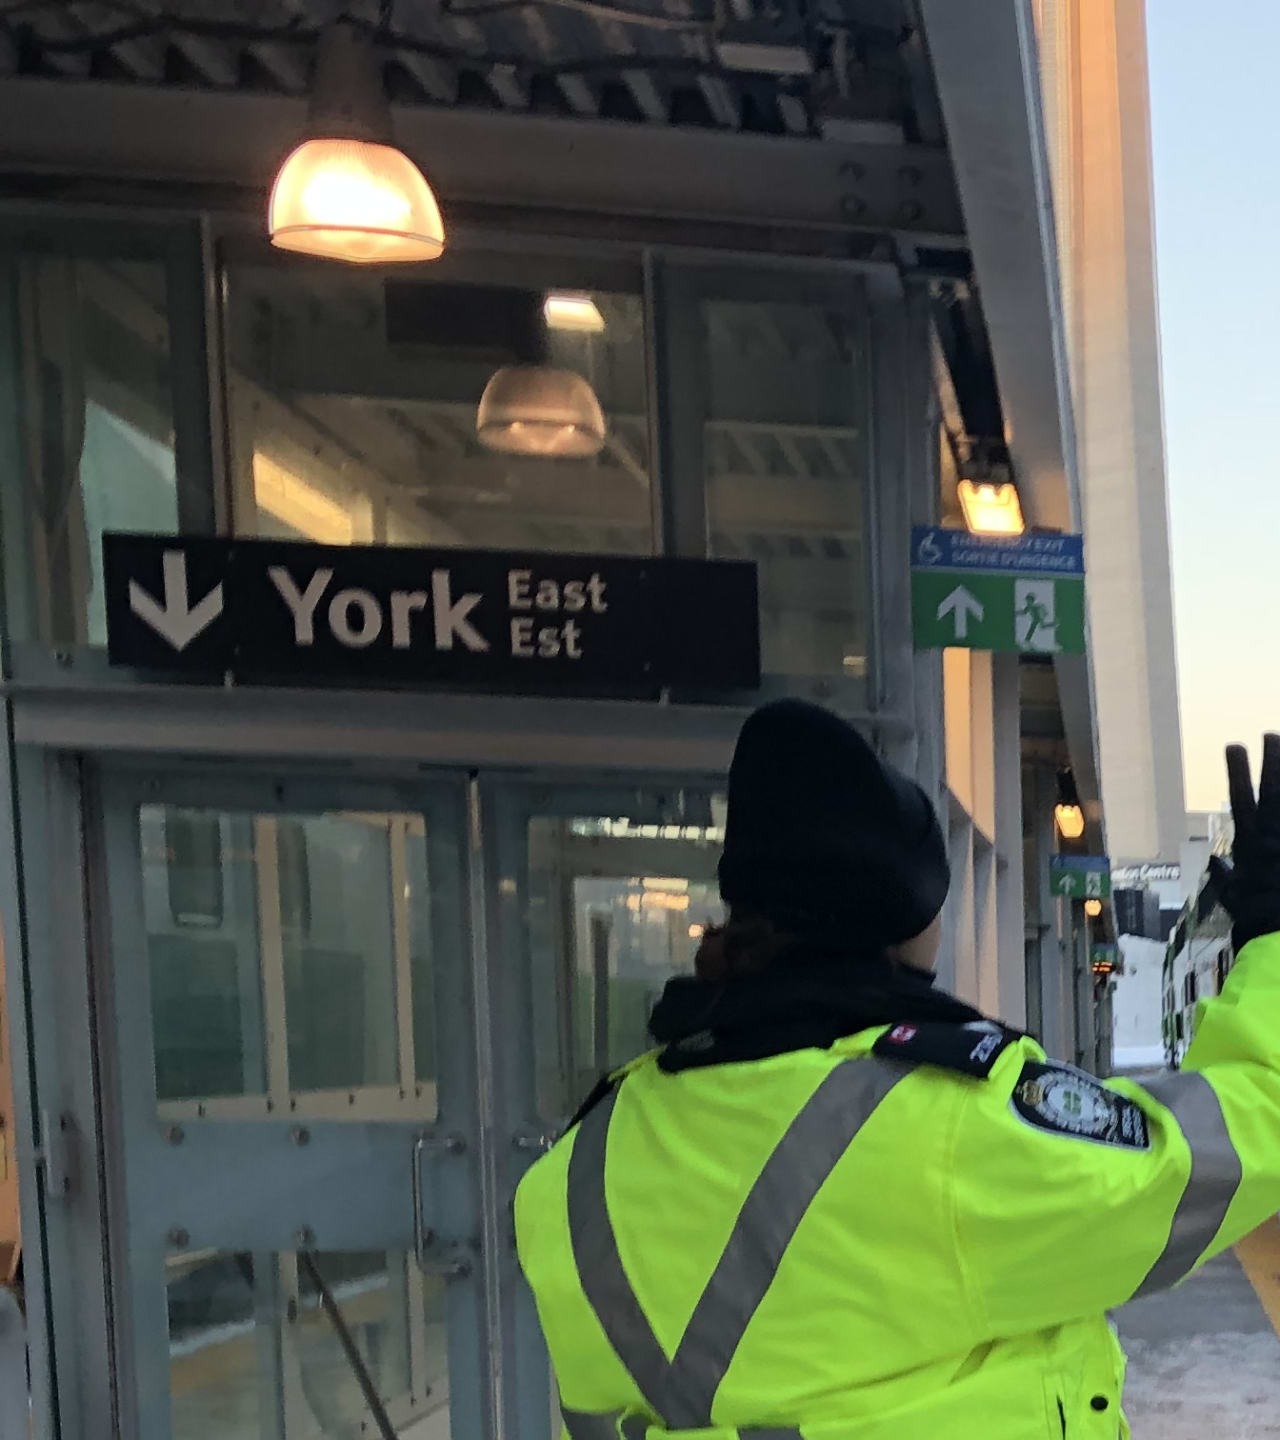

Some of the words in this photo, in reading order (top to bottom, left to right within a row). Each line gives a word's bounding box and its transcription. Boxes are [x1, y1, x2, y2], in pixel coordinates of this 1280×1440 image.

[267, 565, 491, 652] York
[508, 569, 608, 614] East
[510, 616, 582, 659] Est
